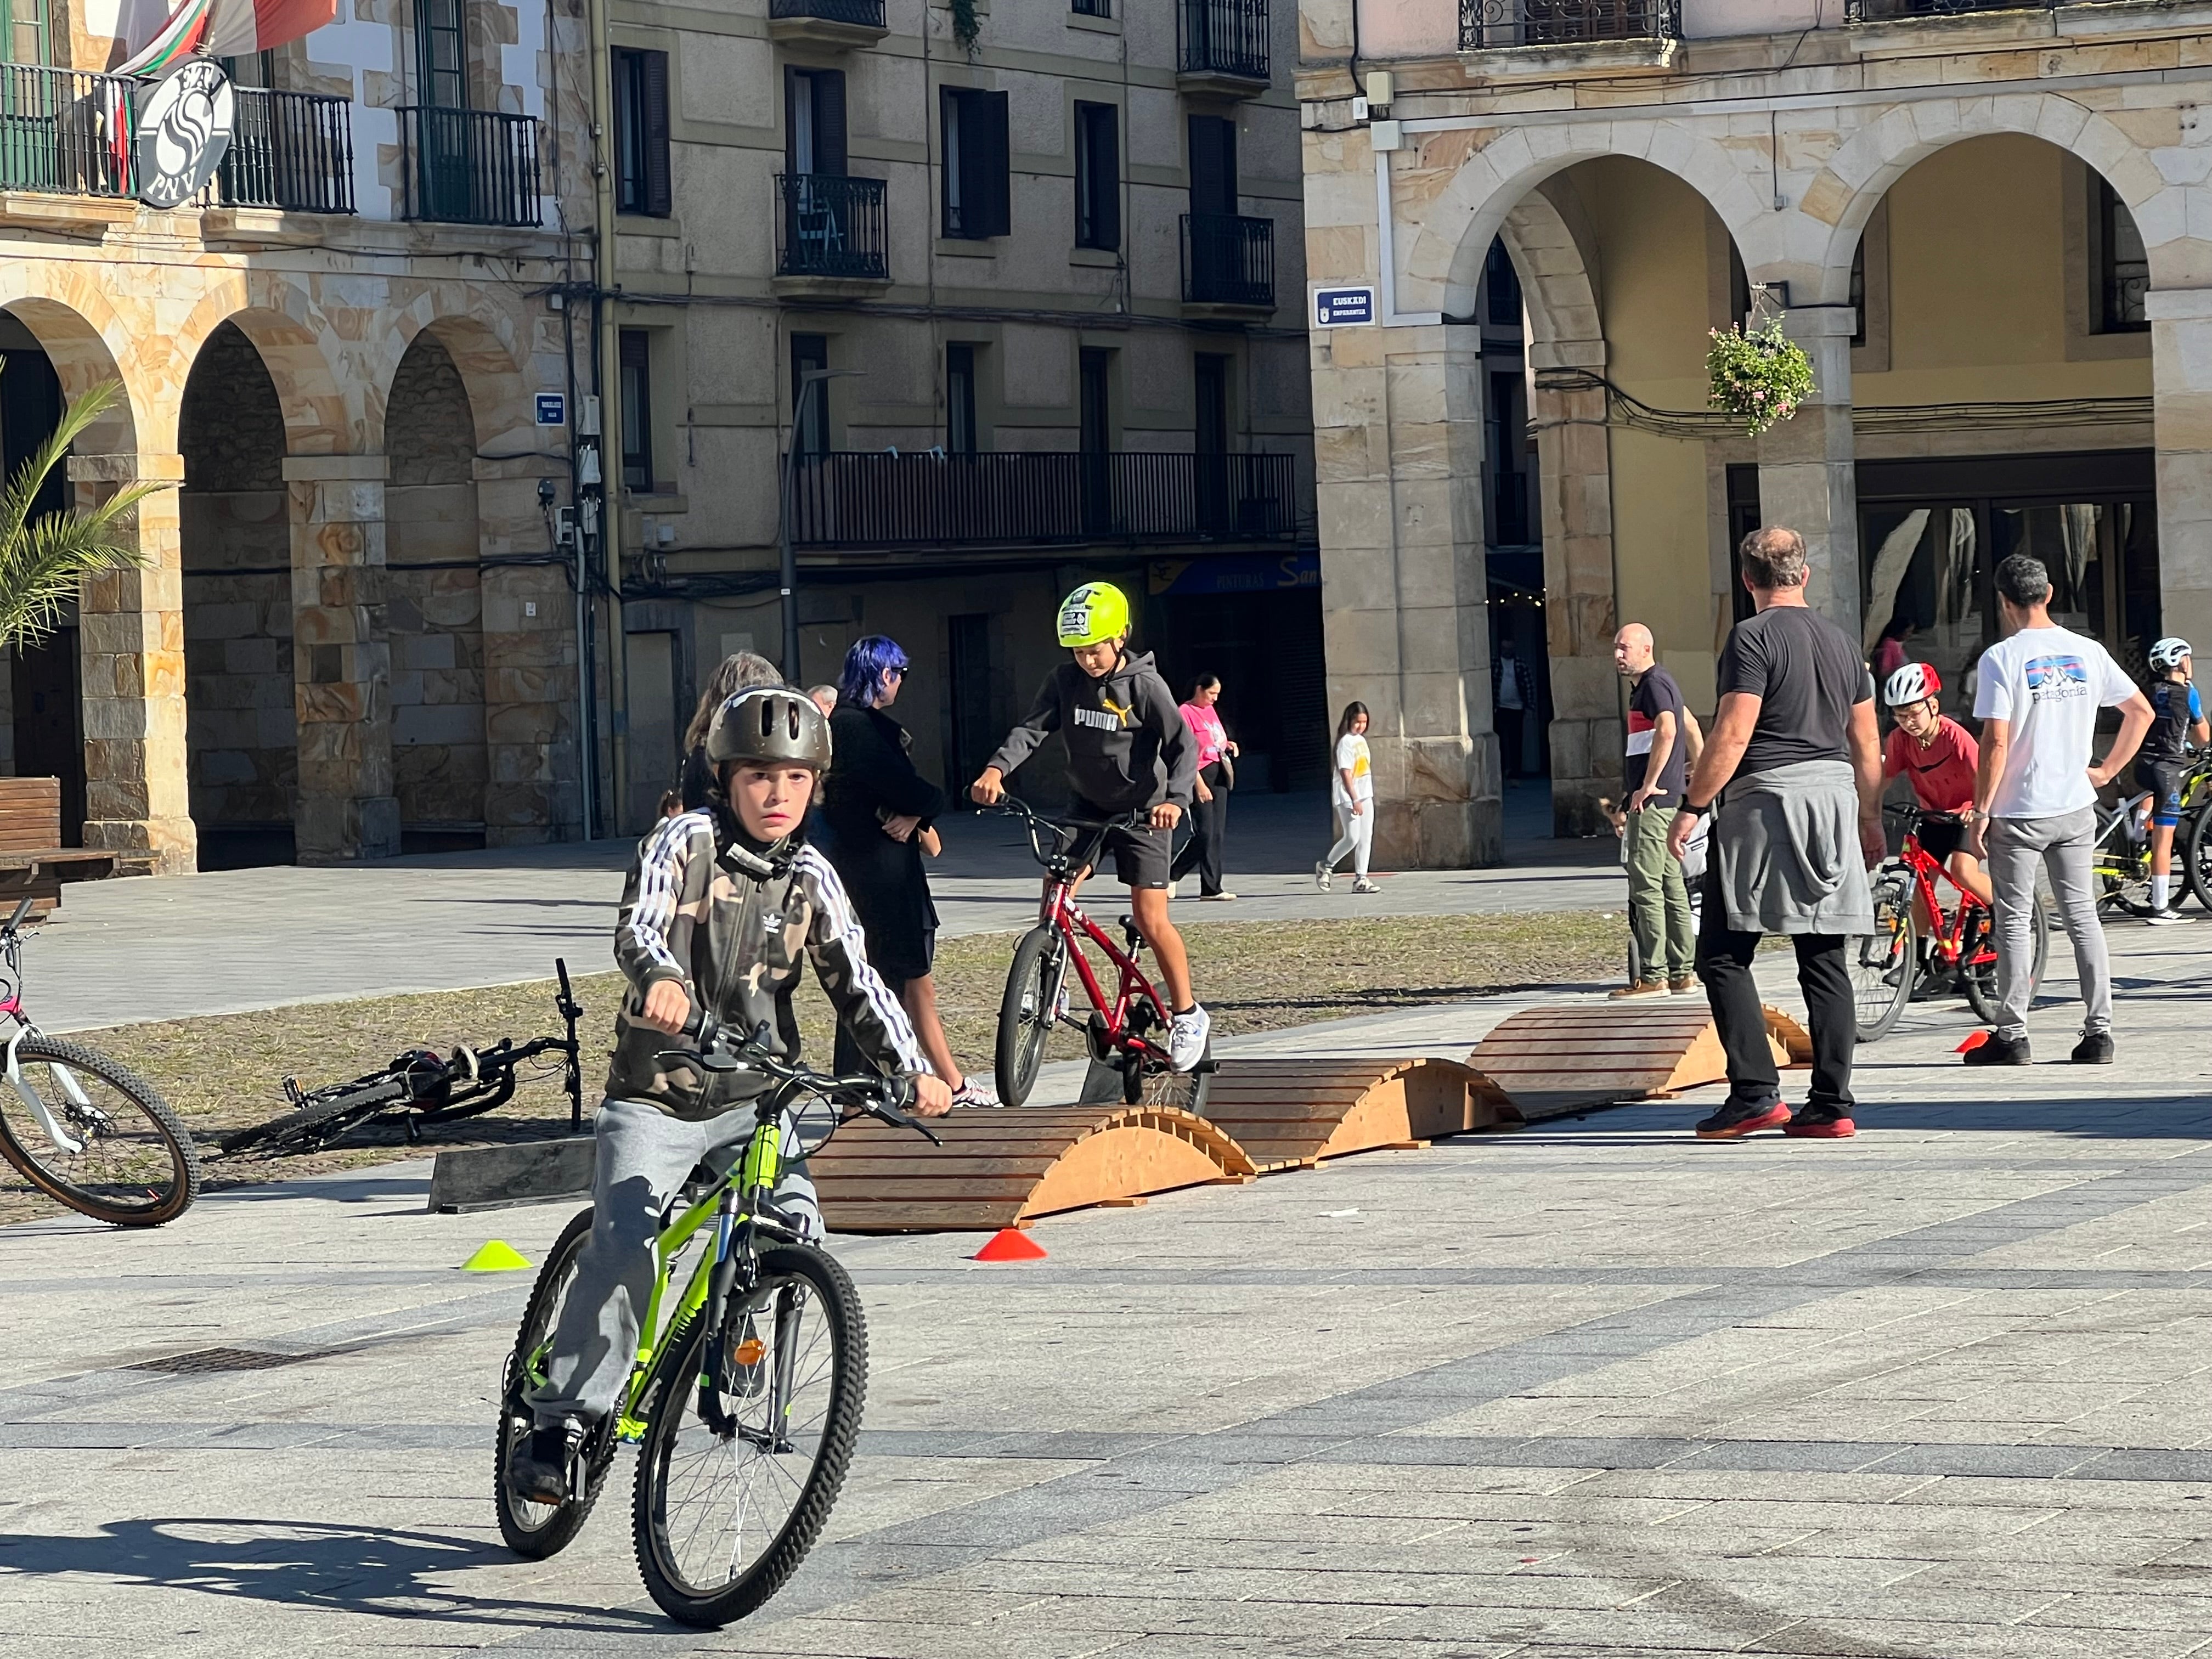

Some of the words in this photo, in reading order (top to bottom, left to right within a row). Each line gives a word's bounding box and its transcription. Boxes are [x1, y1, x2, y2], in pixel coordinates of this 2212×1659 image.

[146, 166, 196, 201] PNV
[1333, 296, 1367, 306] EUSKADI
[1216, 573, 1264, 590] PINTURAS
[2032, 686, 2087, 704] patagonia
[1075, 708, 1119, 732] PUMA
